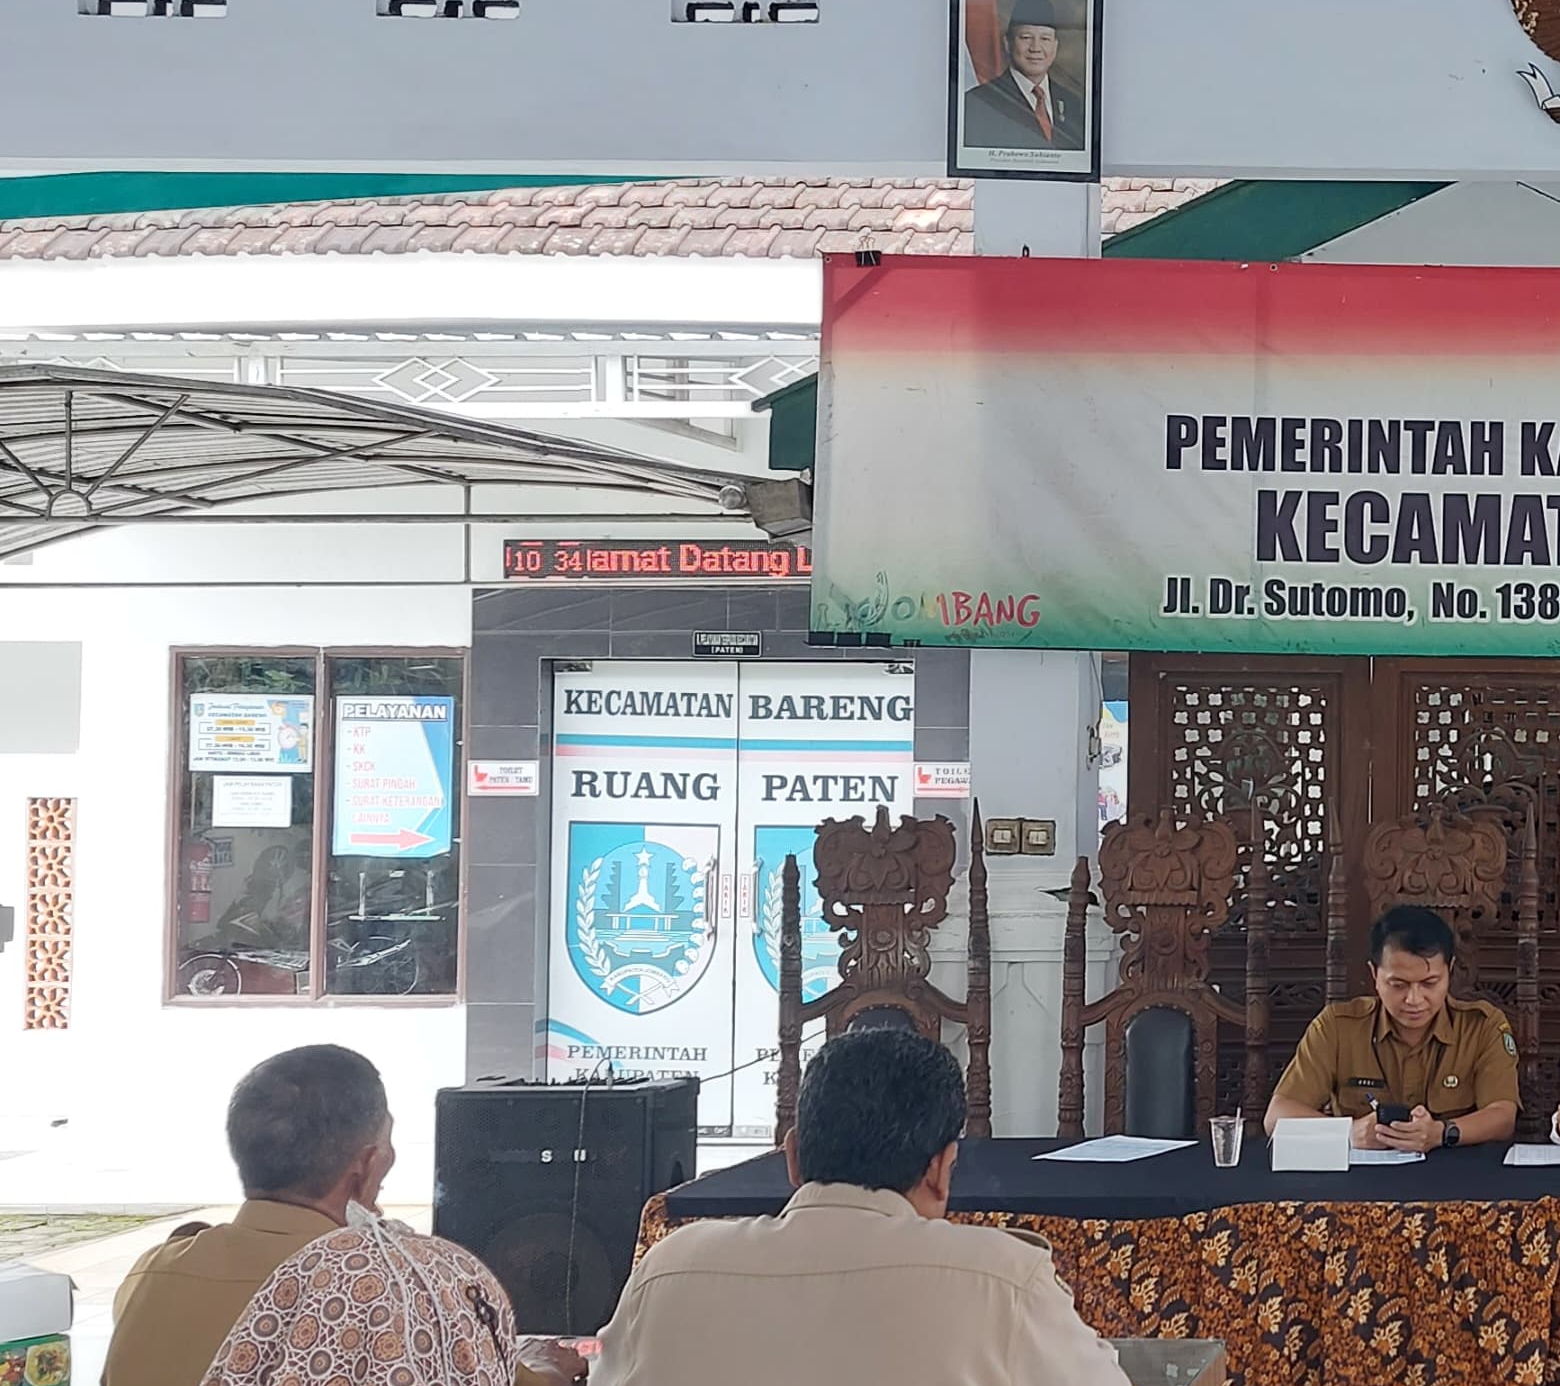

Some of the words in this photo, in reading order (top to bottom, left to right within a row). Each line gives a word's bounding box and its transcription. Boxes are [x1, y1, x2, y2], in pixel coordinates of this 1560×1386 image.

[1165, 414, 1505, 476] PEMERINTAH
[512, 549, 541, 572] 10
[553, 549, 583, 572] 34
[680, 544, 791, 577] Datang
[1163, 577, 1200, 614] Jl.
[1209, 577, 1255, 615] Dr.
[1264, 578, 1415, 623] Sutomo,
[1432, 581, 1488, 620] No.
[1495, 582, 1560, 621] 138
[342, 703, 447, 719] PELAYANAN
[563, 689, 735, 718] KECAMATAN
[747, 694, 915, 722] BARENG
[351, 777, 380, 789] SURAT
[382, 778, 416, 790] PINDAH
[570, 769, 722, 801] RUANG
[761, 774, 899, 803] PATEN
[351, 795, 380, 806] SURAT
[567, 1045, 709, 1061] PEMERINTAH
